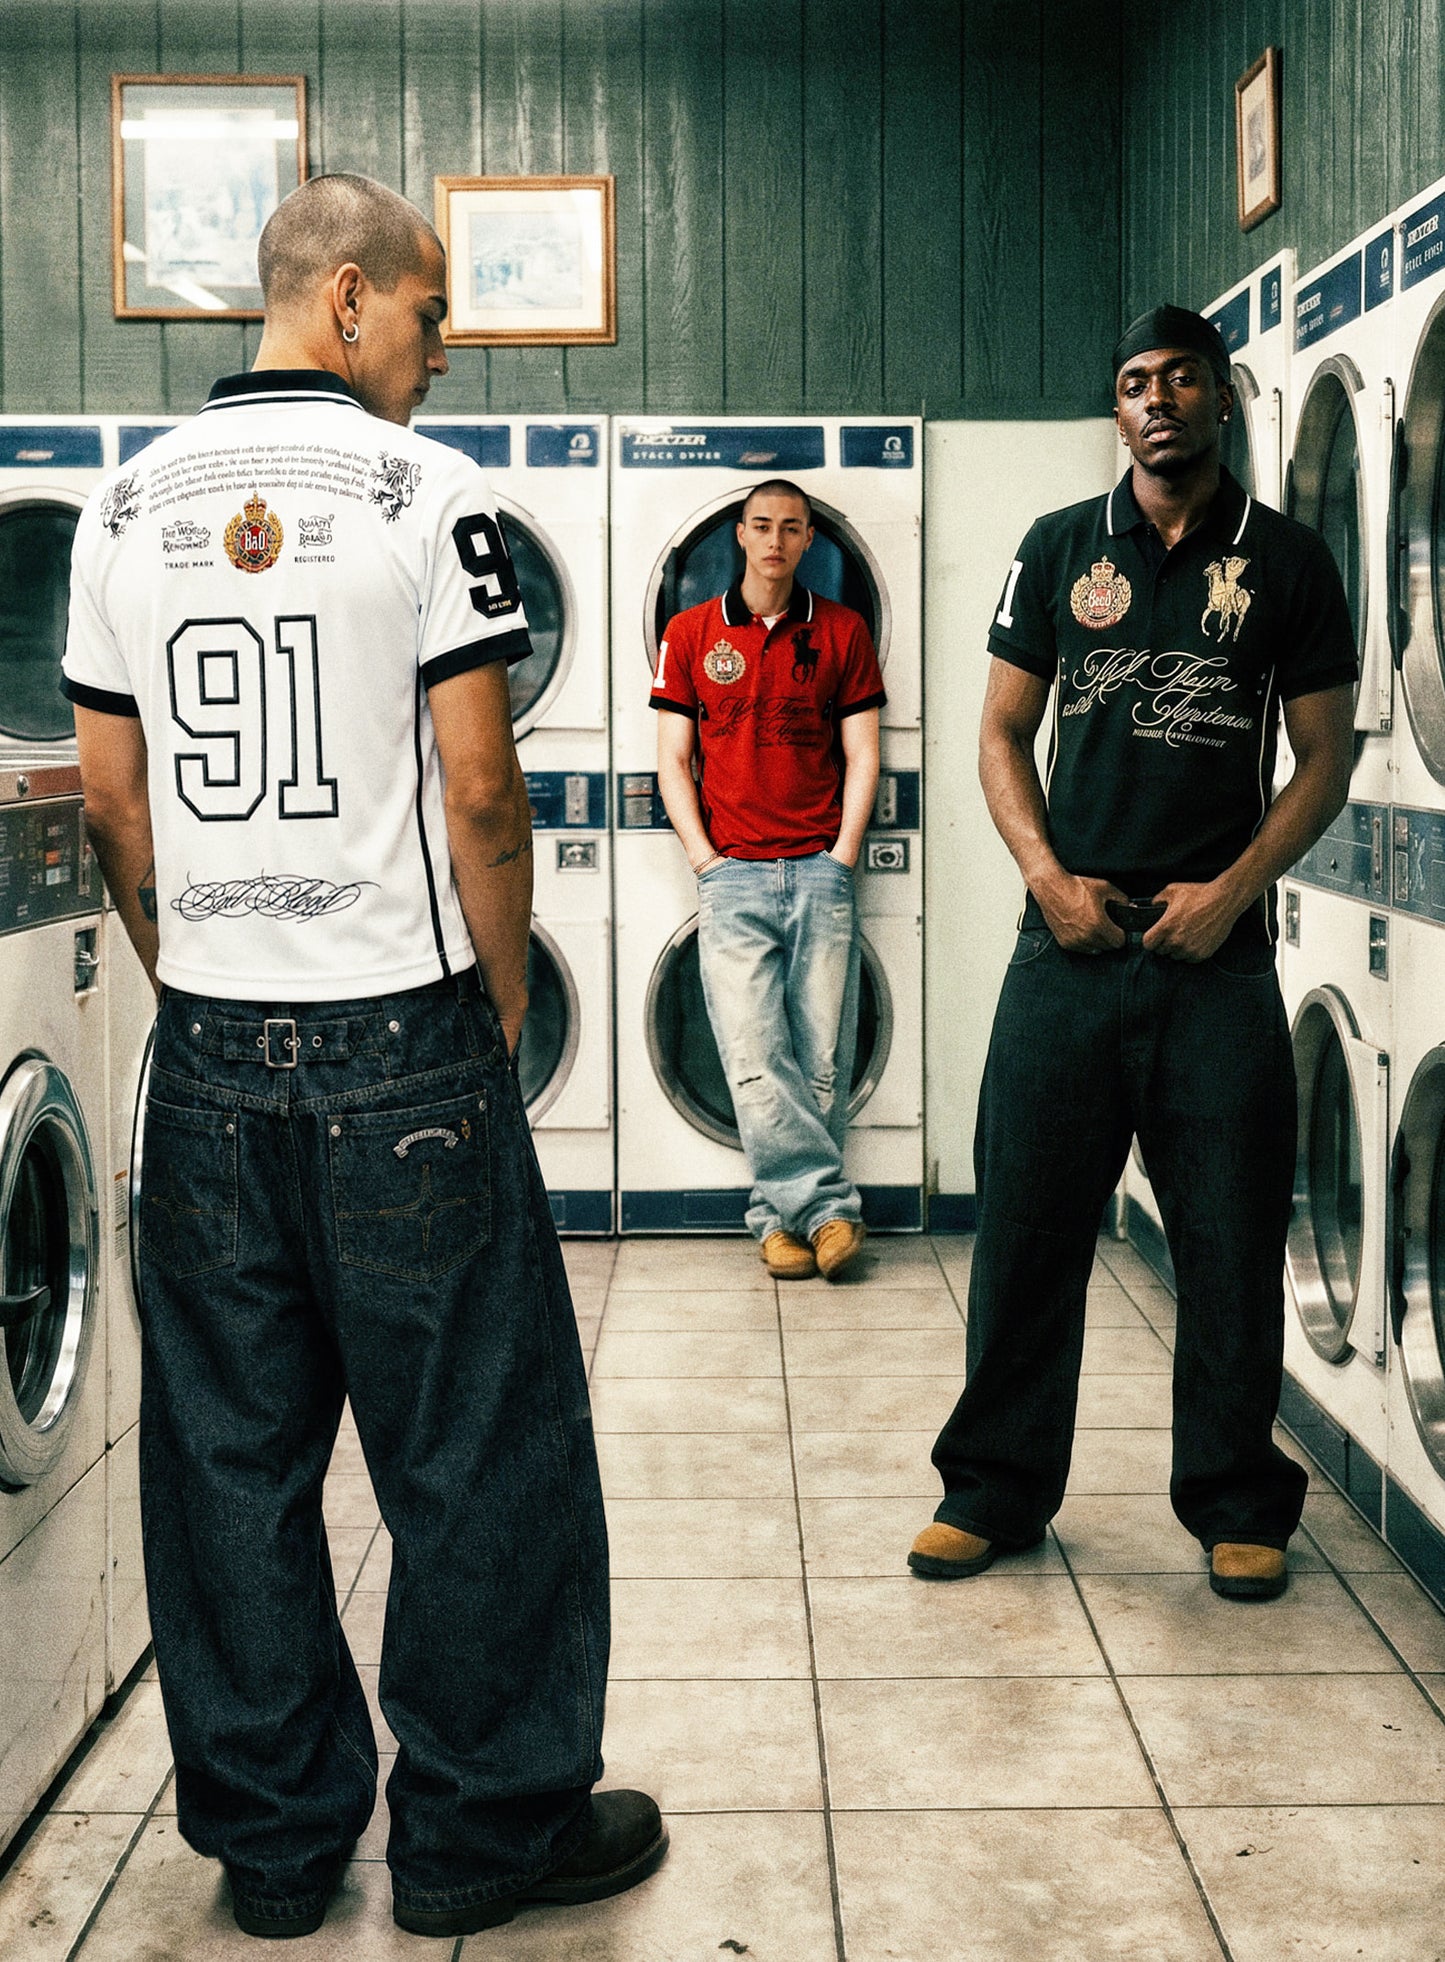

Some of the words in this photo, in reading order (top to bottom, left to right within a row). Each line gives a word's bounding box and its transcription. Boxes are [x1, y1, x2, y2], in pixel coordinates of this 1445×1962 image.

[164, 561, 190, 569] TRADE
[192, 560, 214, 568] MARK
[996, 559, 1024, 629] 1
[653, 640, 669, 689] 1
[166, 614, 339, 822] 91
